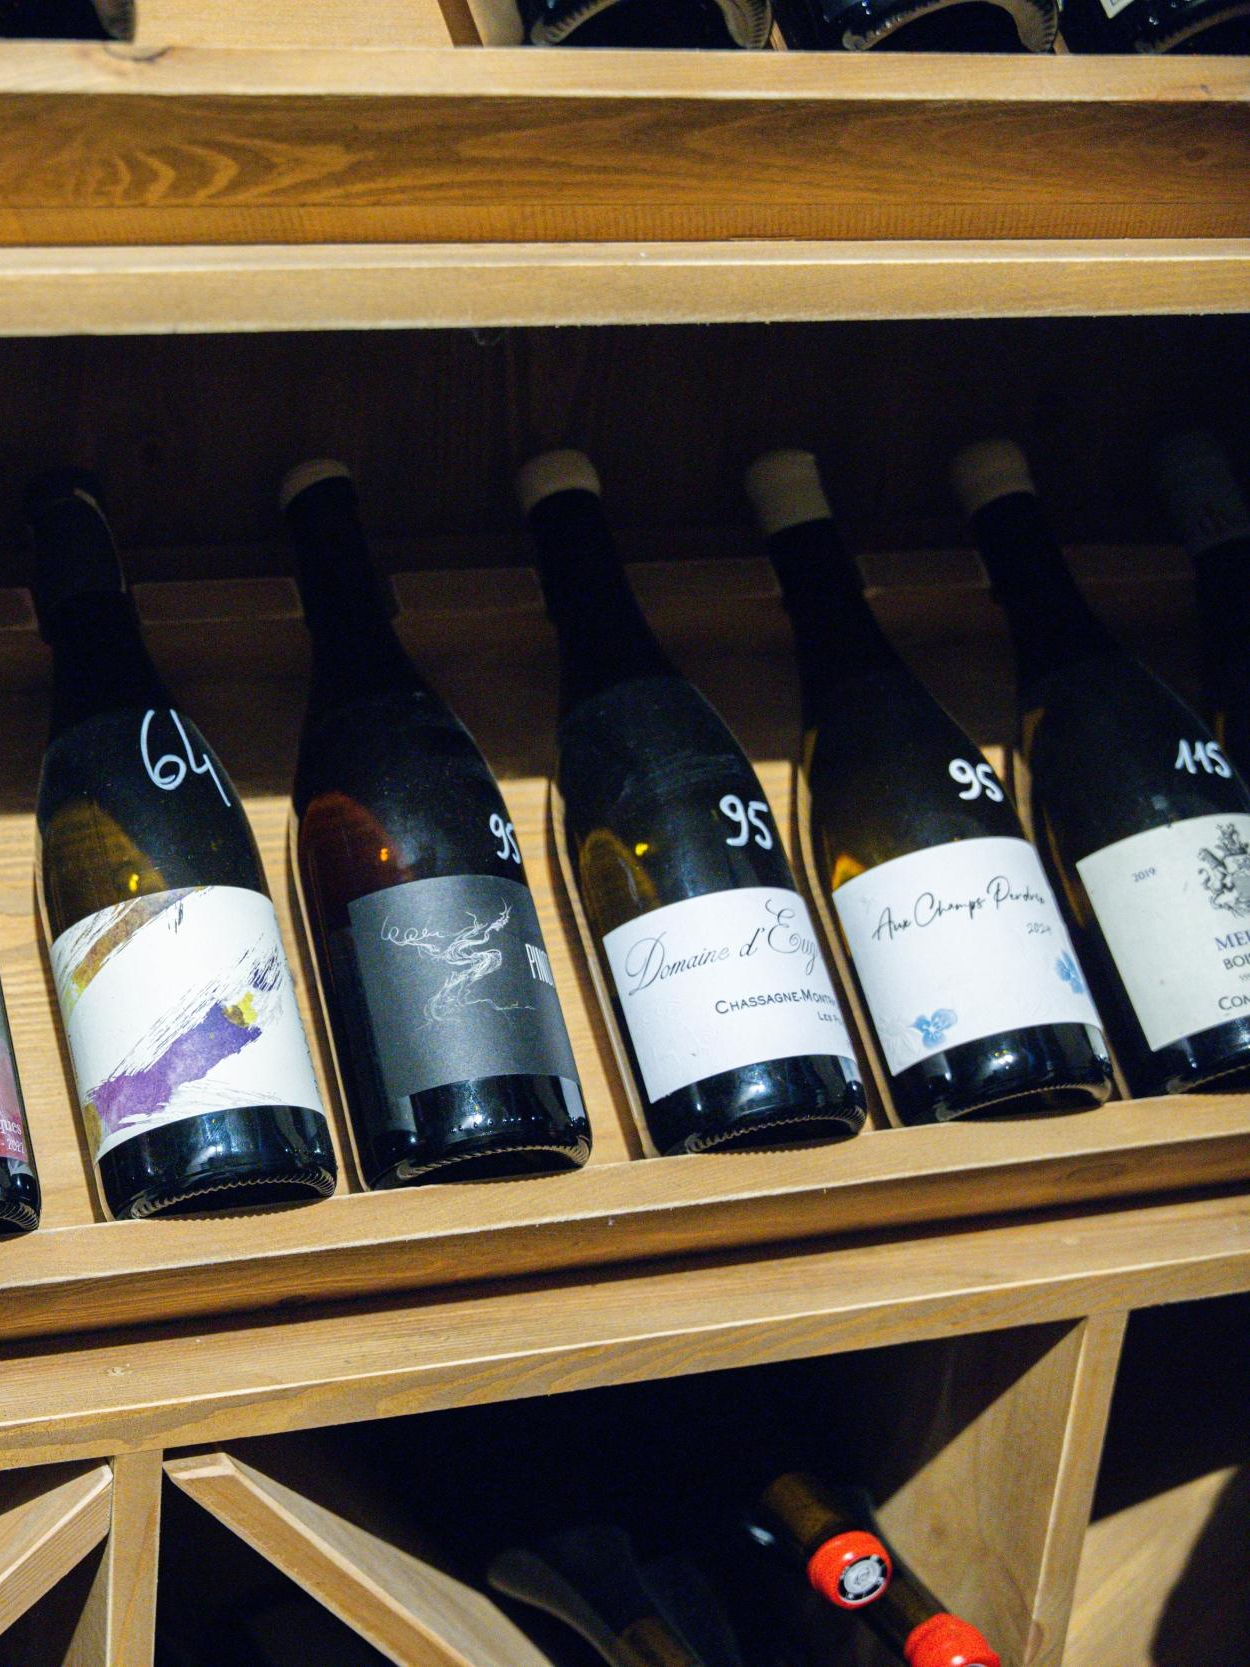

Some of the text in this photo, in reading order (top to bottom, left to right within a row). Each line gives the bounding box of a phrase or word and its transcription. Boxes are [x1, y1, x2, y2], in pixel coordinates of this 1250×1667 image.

[141, 709, 231, 807] 64
[949, 758, 1004, 802] 95
[1174, 739, 1232, 778] 115
[489, 813, 521, 864] 95
[719, 794, 773, 849] 95
[1131, 867, 1156, 883] 2019
[872, 907, 911, 941] Aux
[914, 892, 986, 928] Champs
[625, 931, 730, 996] Domaine
